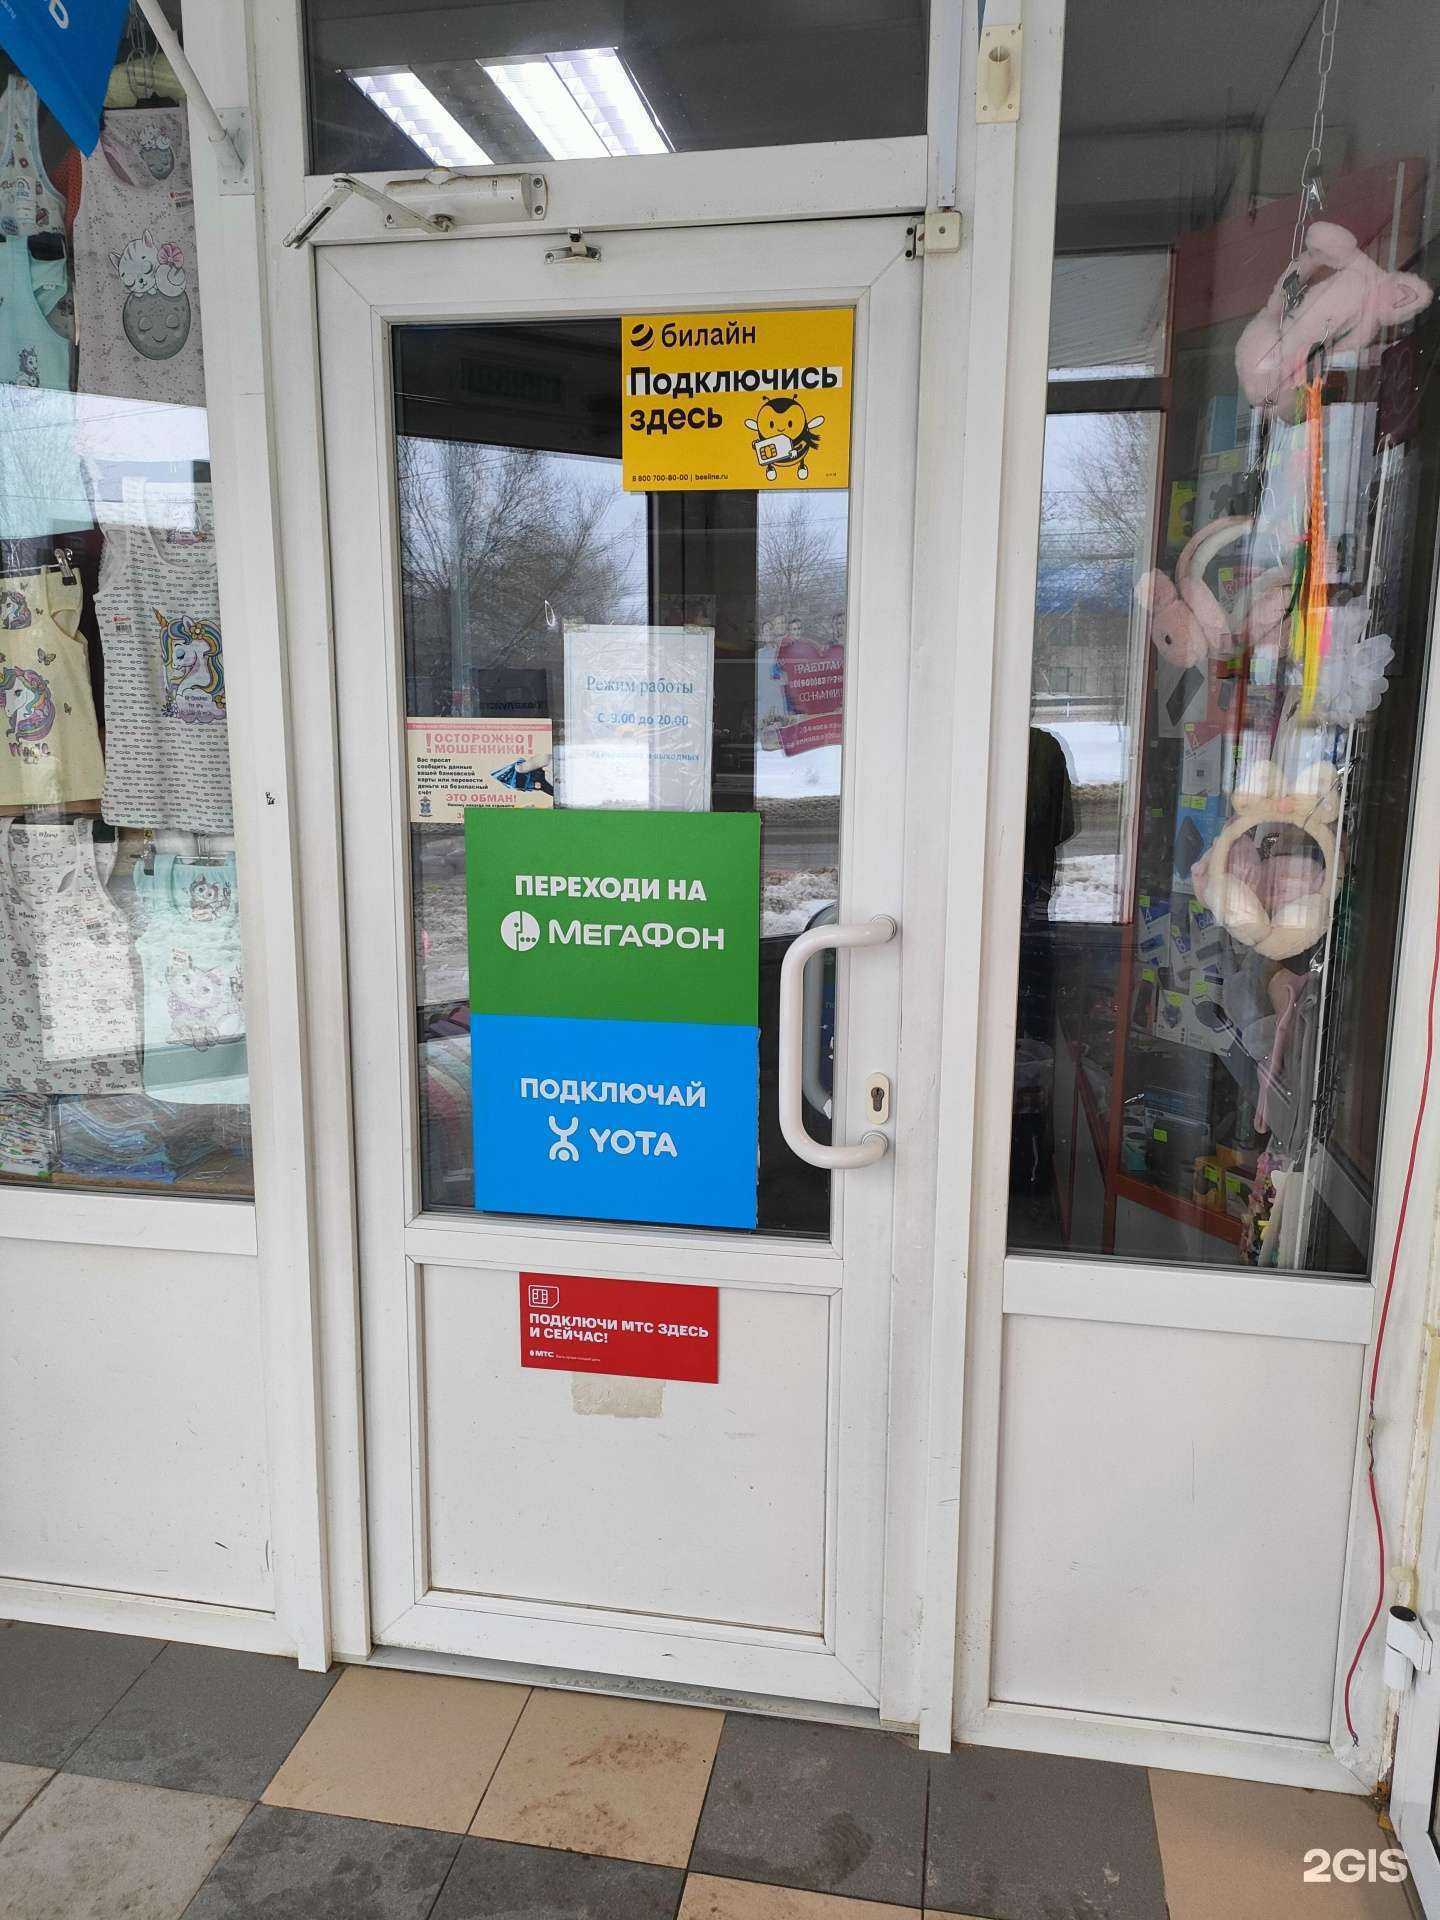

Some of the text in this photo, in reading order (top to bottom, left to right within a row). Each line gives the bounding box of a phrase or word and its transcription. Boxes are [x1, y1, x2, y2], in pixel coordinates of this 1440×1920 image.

[661, 321, 756, 347] билайн
[630, 366, 838, 399] Подключись
[630, 407, 723, 435] здесь
[653, 473, 688, 481] 700-80-00
[695, 472, 729, 481] beeline.ru
[586, 675, 693, 697] Режим работы
[638, 715, 654, 726] до
[658, 714, 689, 726] 20.00
[447, 793, 517, 803] ЭТО ОБМАН!
[515, 875, 707, 902] ПЕРЕХОДИ НА
[520, 1077, 706, 1108] ПОДКЛЮЧАЙ
[589, 1127, 678, 1158] YOTA
[529, 1313, 710, 1338] ПОДКЛЮЧИ МТС ЗДЕСЬ
[529, 1326, 608, 1344] И СЕЙЧАС!
[535, 1350, 555, 1358] МТС
